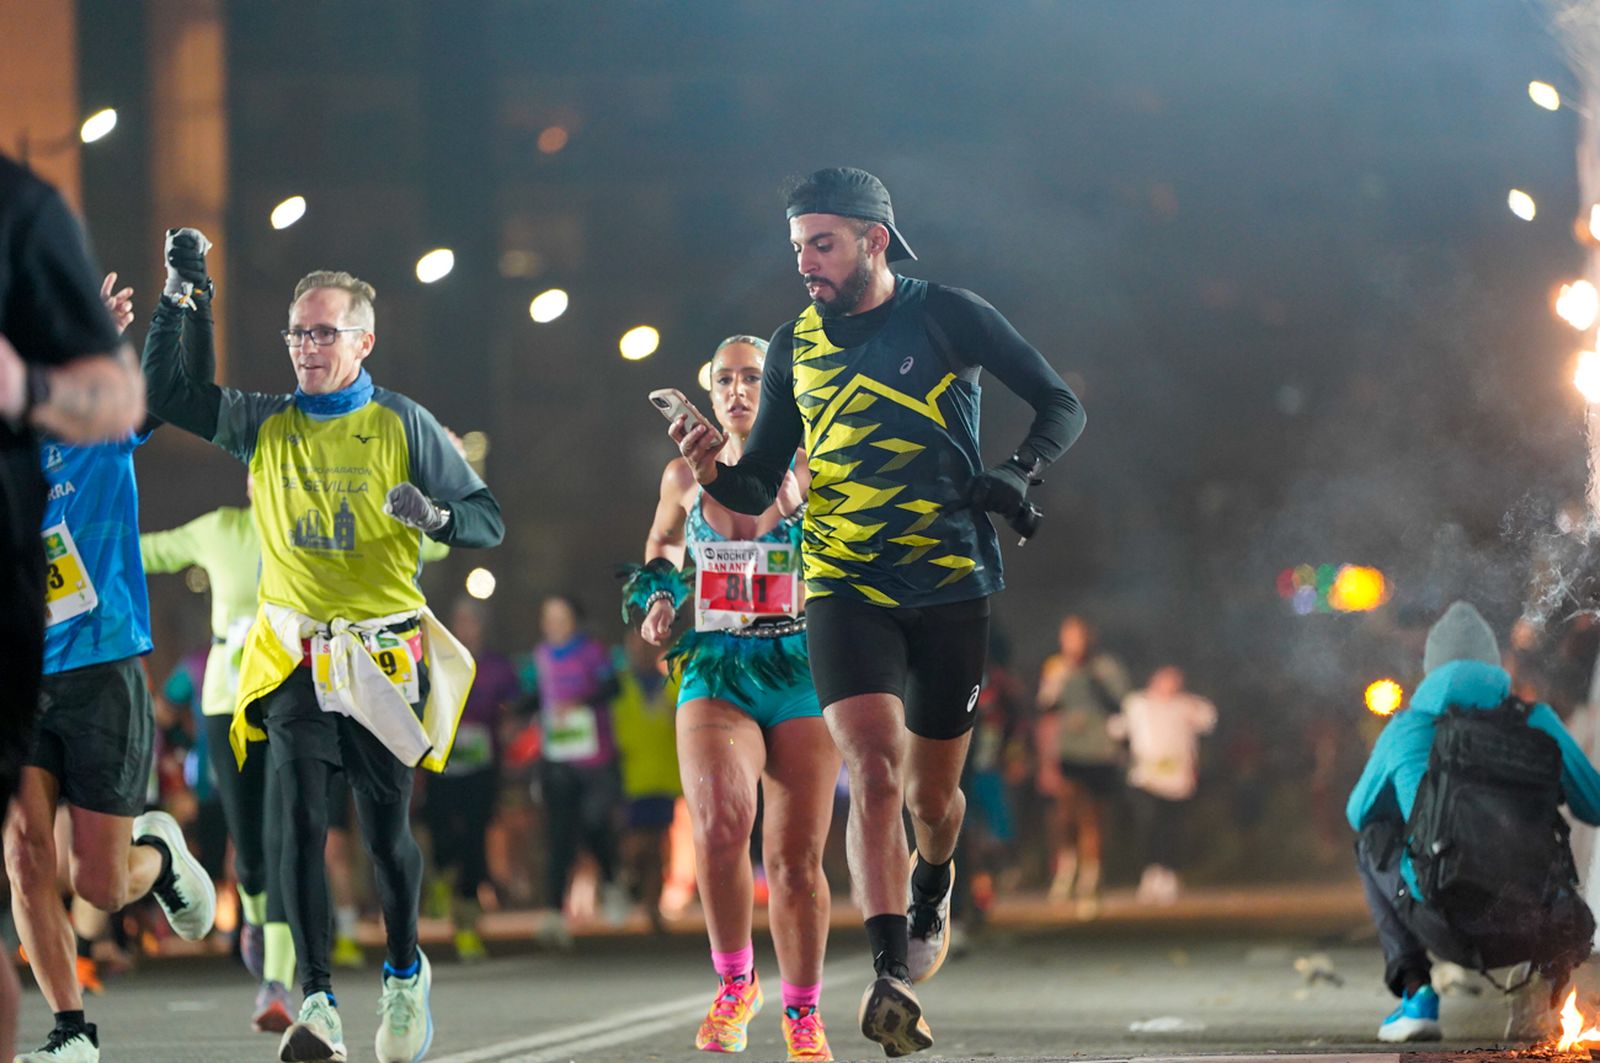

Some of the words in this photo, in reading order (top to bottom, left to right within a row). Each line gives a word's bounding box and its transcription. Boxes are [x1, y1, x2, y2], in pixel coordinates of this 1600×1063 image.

[304, 479, 369, 493] SEVILLA
[717, 552, 746, 561] NOCHE
[708, 562, 726, 572] SAN
[729, 562, 759, 573] ANTN
